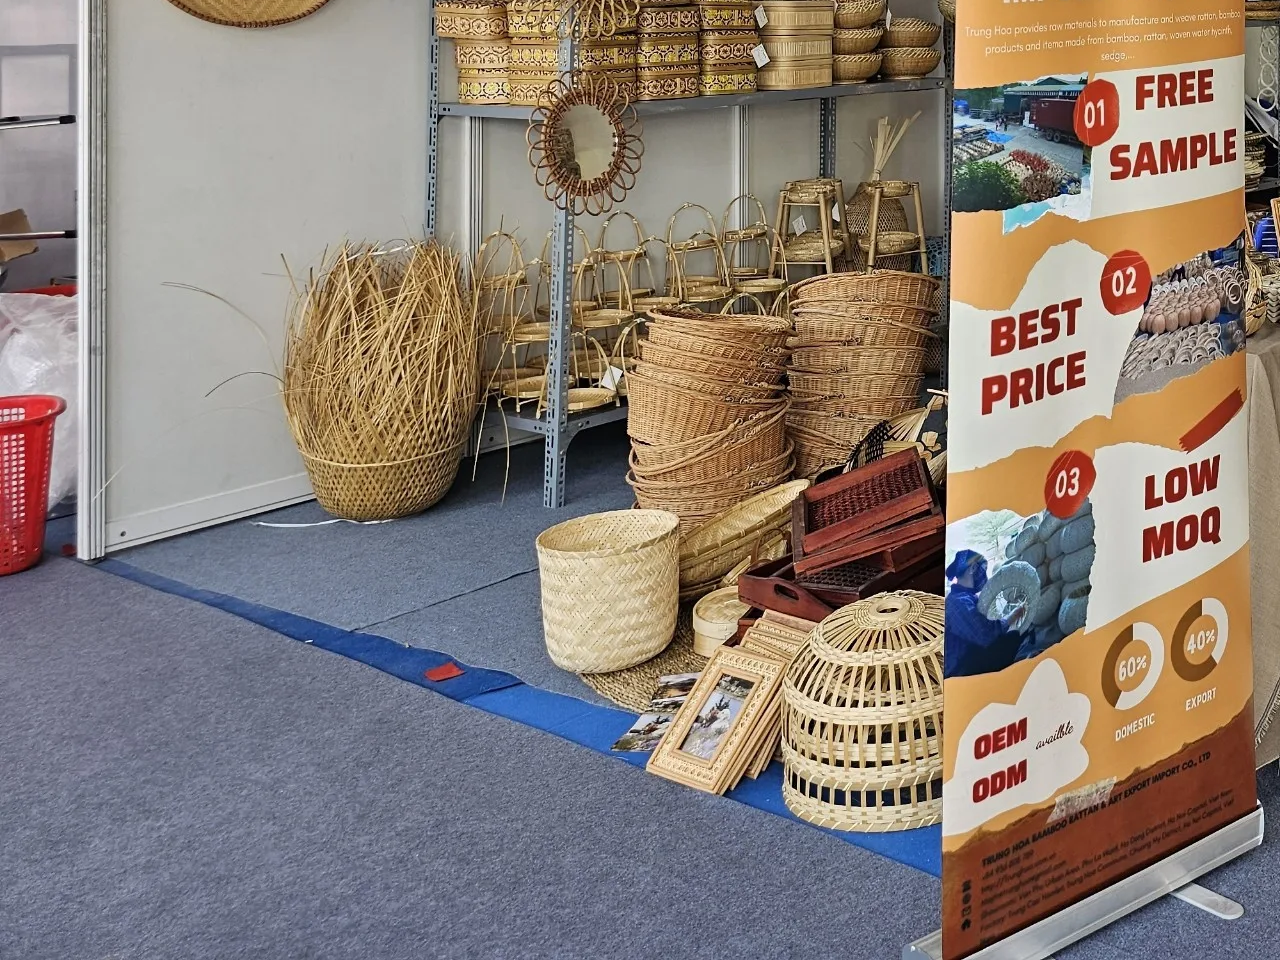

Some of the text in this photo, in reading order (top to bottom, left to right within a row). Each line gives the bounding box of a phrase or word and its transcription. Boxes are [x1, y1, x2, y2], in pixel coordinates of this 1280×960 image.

[965, 26, 992, 39] Trung
[994, 25, 1012, 36] Hoa
[1014, 22, 1048, 37] provides
[1049, 23, 1063, 32] raw
[1065, 17, 1098, 30] materials
[1099, 18, 1107, 27] to
[1109, 15, 1159, 26] manufacture
[1161, 13, 1174, 23] and
[1175, 14, 1197, 23] weave
[985, 42, 1024, 57] products
[1025, 40, 1041, 52] and
[1065, 36, 1085, 47] made
[1087, 34, 1104, 46] from
[1106, 33, 1142, 44] bamboo,
[1143, 32, 1168, 41] rattan,
[1169, 30, 1191, 40] woven
[1192, 28, 1210, 37] water
[1135, 68, 1214, 111] FREE
[1084, 98, 1106, 129] 01
[1109, 128, 1237, 181] SAMPLE
[1111, 266, 1137, 298] 02
[990, 297, 1083, 357] BEST
[981, 350, 1087, 416] PRICE
[1055, 467, 1080, 499] 03
[1144, 454, 1221, 511] LOW
[1142, 505, 1222, 563] MOQ
[1186, 628, 1215, 655] 40%
[1118, 655, 1147, 682] 60%
[1185, 687, 1217, 712] EXPORT
[973, 716, 1028, 760] OEM
[1115, 713, 1155, 742] DOMESTIC
[972, 758, 1028, 804] ODM
[982, 847, 1010, 866] TRUNG
[1012, 838, 1031, 854] HOA
[1032, 820, 1067, 845] BAMBOO
[1068, 804, 1099, 826] RATTAN
[1100, 800, 1107, 811] &
[1107, 792, 1123, 808] ART
[1124, 777, 1151, 800] EXPORT
[1151, 765, 1181, 784] IMPORT
[1181, 759, 1197, 772] CO.,
[1198, 751, 1211, 765] LTD
